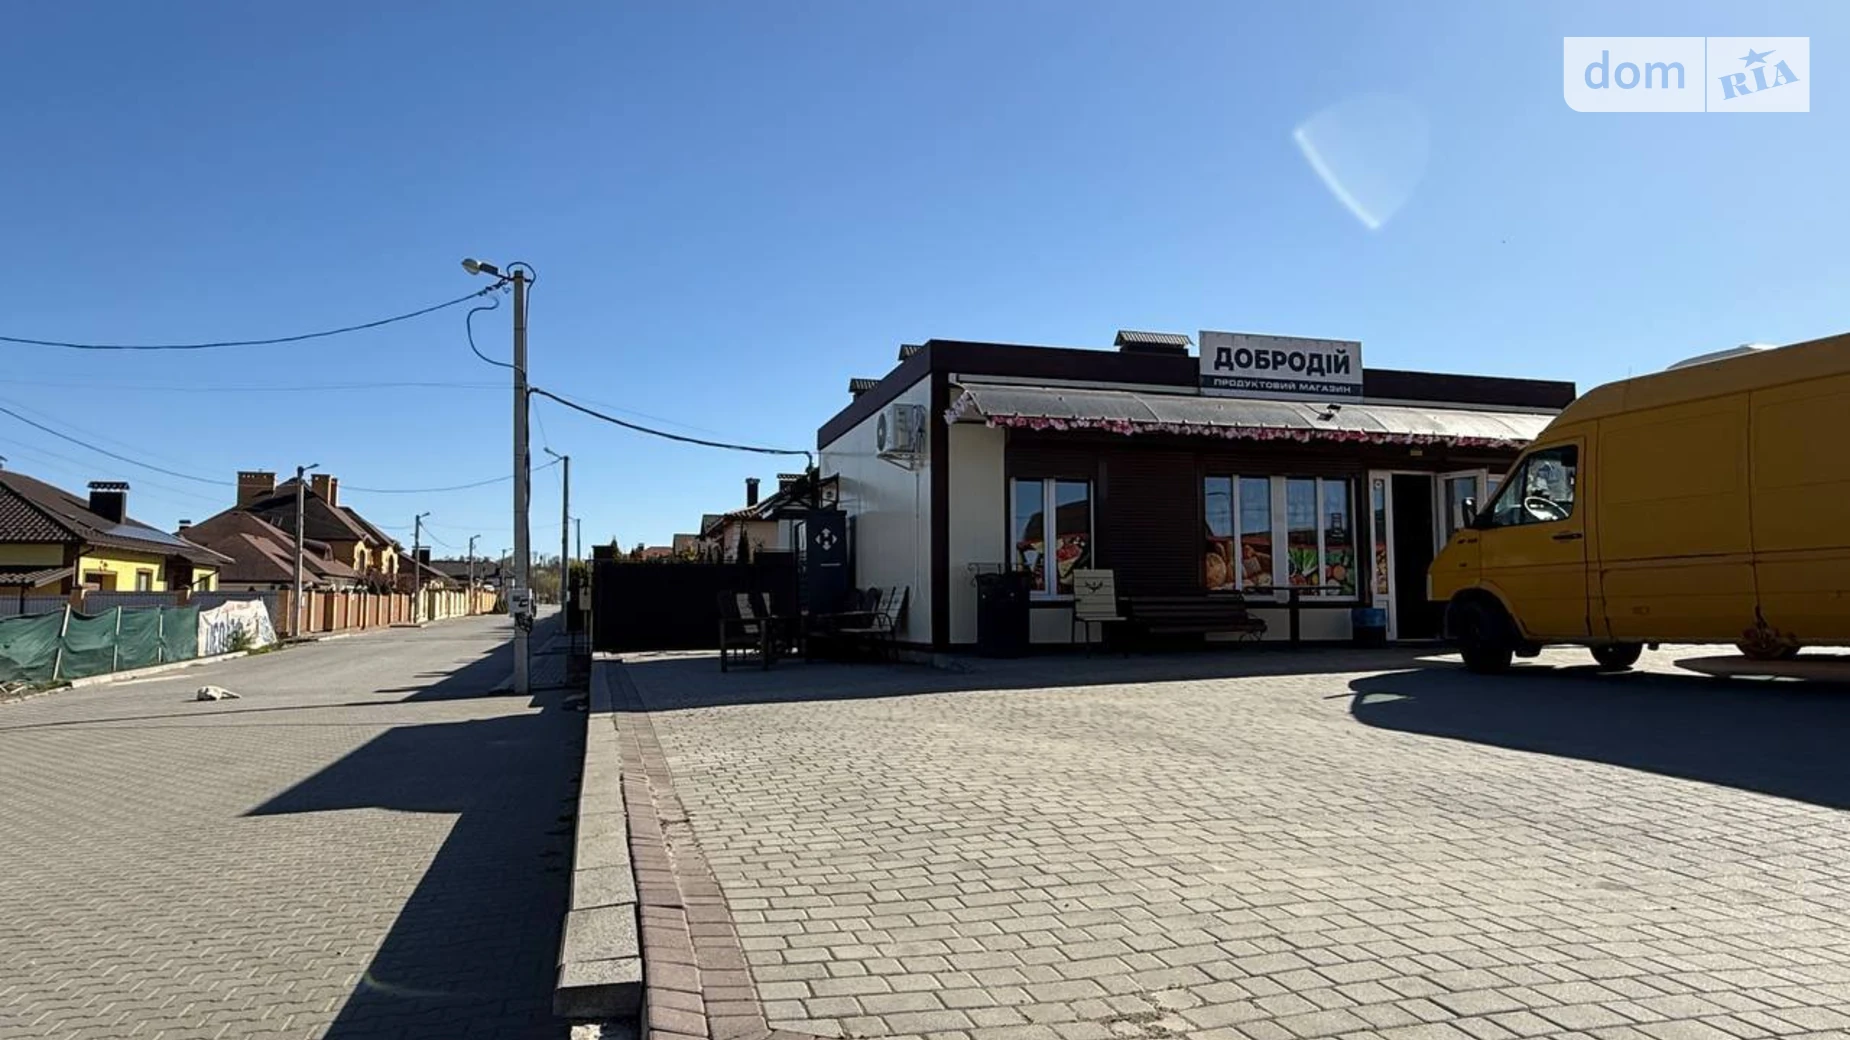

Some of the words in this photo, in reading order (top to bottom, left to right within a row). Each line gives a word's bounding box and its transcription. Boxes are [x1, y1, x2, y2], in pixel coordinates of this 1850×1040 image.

[1213, 346, 1351, 377] ДОБРОДІЙ
[1213, 378, 1297, 391] ПРОДУКТОВИЙ
[1299, 383, 1351, 393] МАГАЗИН
